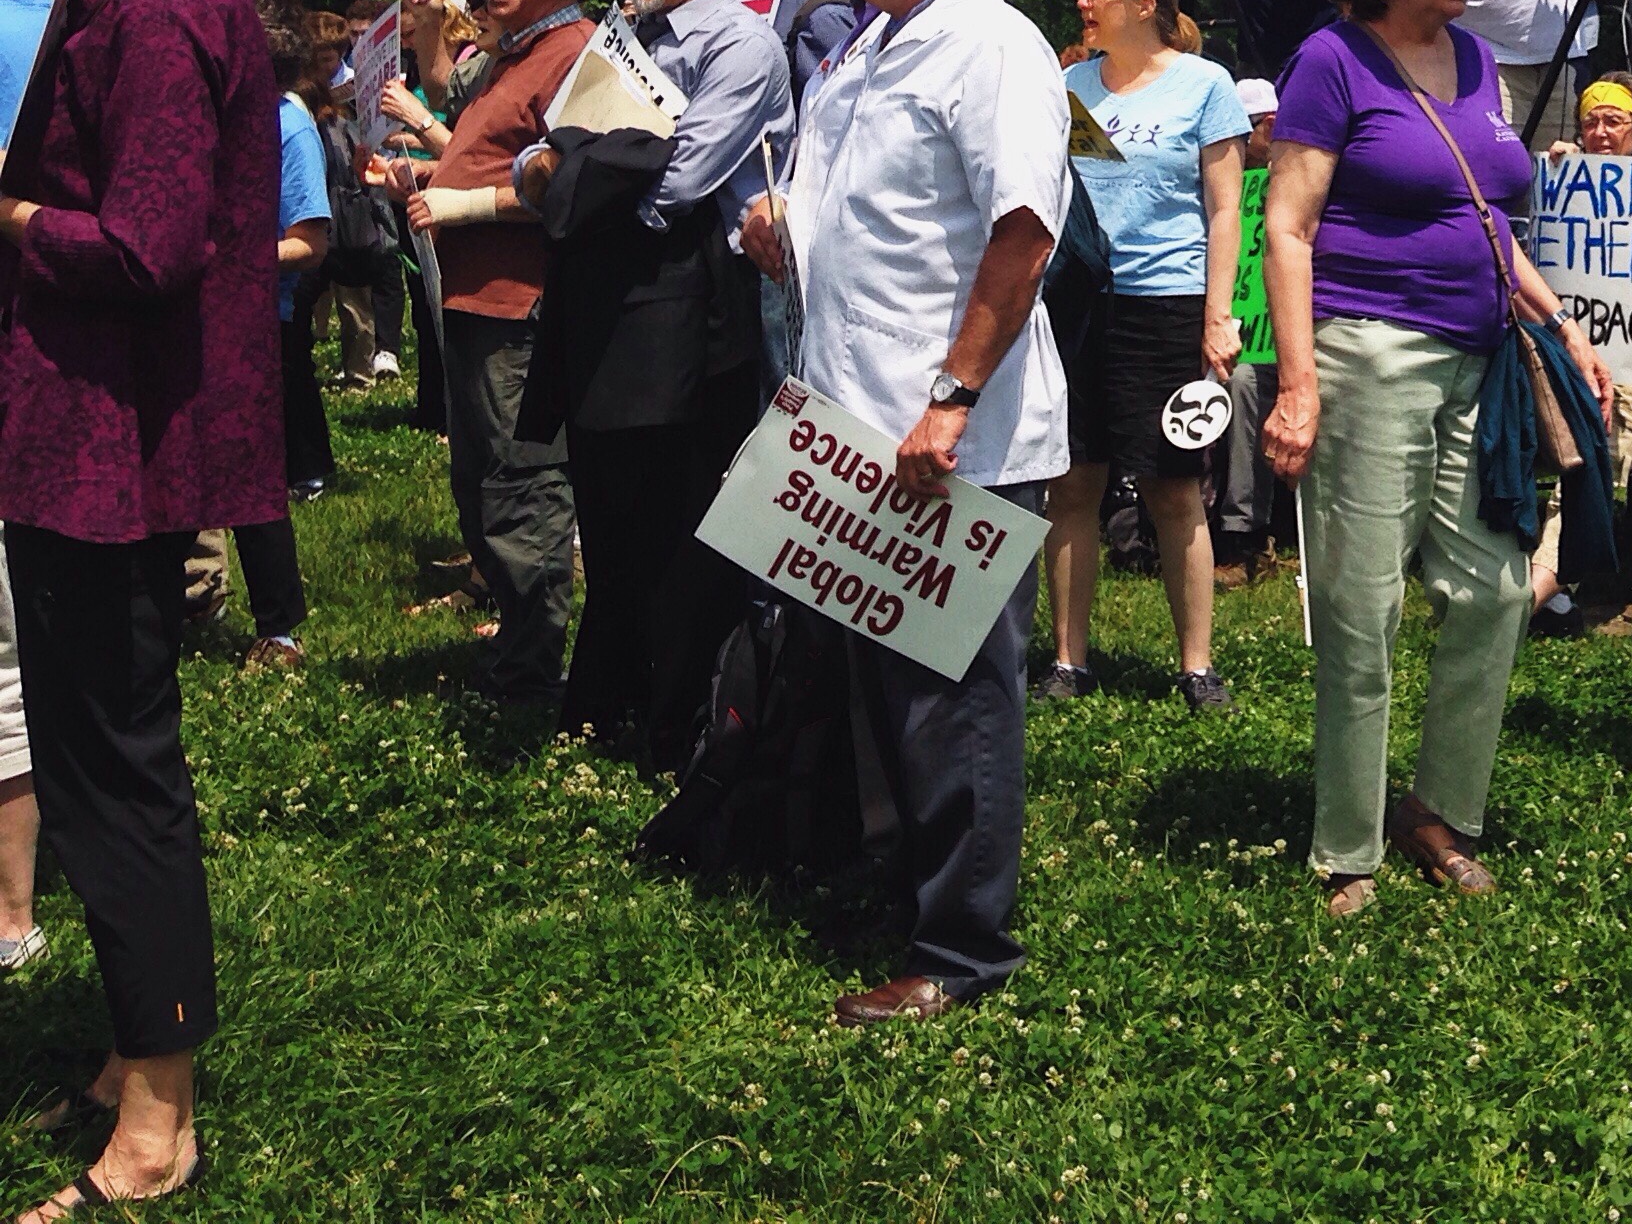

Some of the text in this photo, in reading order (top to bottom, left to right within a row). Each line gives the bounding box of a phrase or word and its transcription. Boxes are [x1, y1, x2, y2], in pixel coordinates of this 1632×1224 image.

[767, 538, 905, 636] Global
[772, 468, 957, 609] Warming
[964, 519, 1008, 571] is
